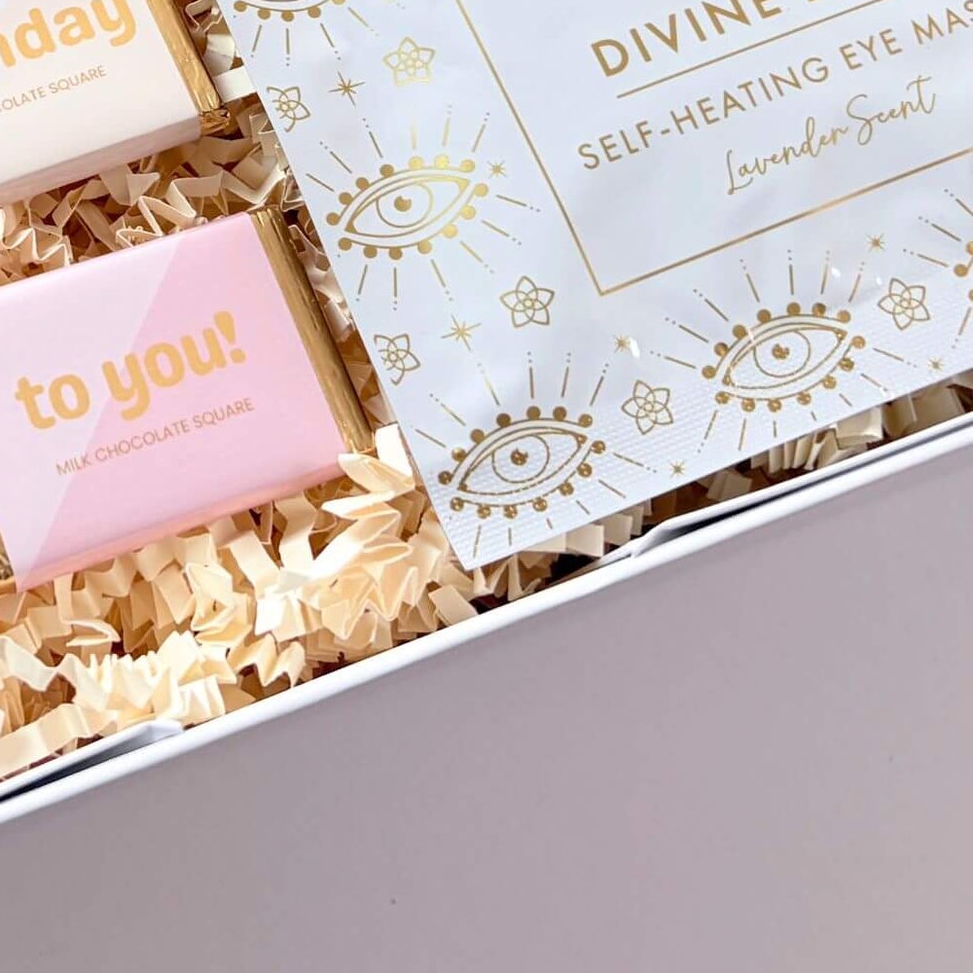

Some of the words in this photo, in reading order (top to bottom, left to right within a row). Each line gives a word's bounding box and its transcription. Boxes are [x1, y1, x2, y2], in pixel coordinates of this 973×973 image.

[48, 65, 107, 95] SQUARE
[578, 56, 827, 170] SELF-HEATING
[838, 29, 902, 70] EYE
[727, 116, 848, 195] Lavender
[846, 75, 936, 145] Scent
[14, 373, 90, 429] to
[102, 310, 246, 422] you!
[56, 453, 91, 475] MILK
[95, 419, 189, 462] CHOCOLATE
[193, 398, 255, 429] SQUARE
